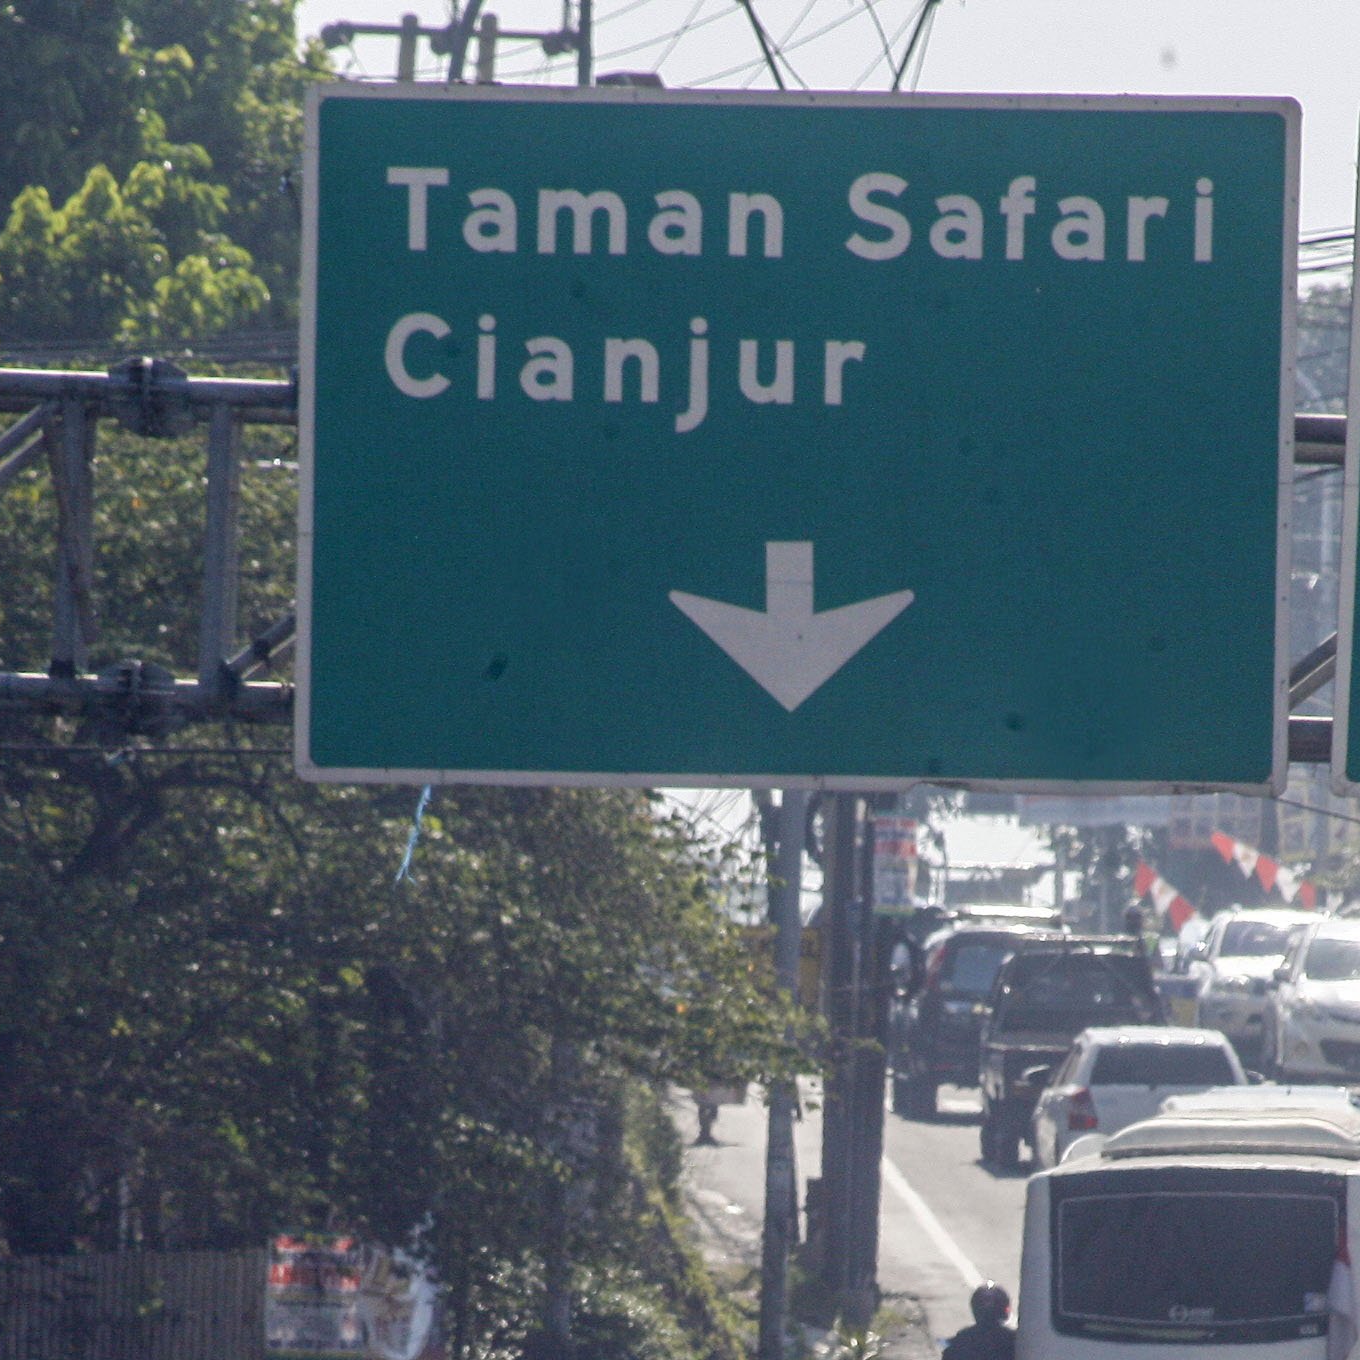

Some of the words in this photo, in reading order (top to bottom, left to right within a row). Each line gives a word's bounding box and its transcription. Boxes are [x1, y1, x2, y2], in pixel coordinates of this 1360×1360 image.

[388, 167, 783, 257] Taman
[846, 173, 1213, 261] Safari
[385, 313, 866, 433] Cianjur
